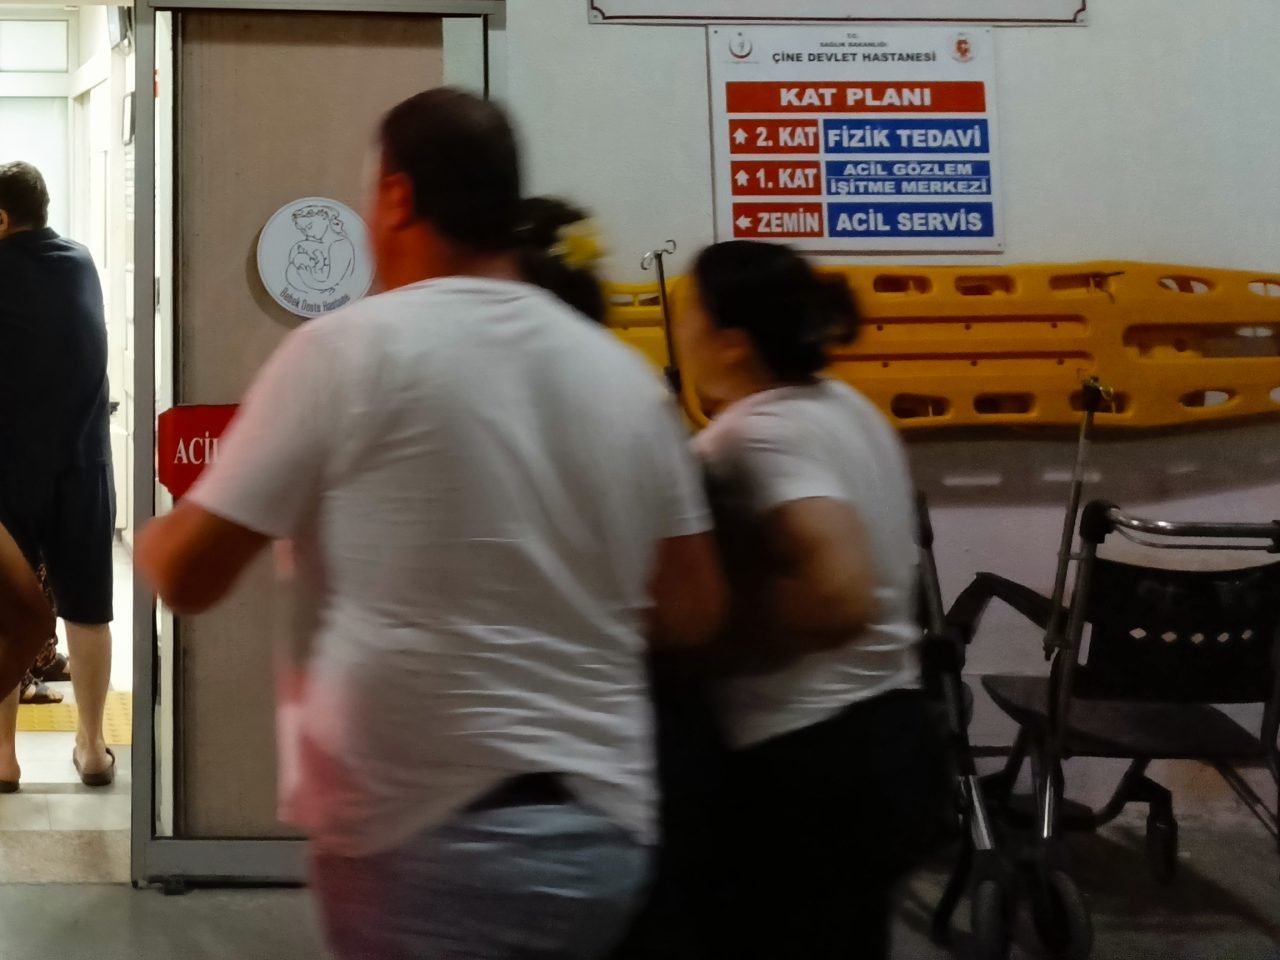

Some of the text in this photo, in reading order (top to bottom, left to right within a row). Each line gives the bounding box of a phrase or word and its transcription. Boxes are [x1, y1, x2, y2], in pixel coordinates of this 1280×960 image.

[772, 52, 803, 64] ÇİNE
[808, 52, 857, 62] DEVLET
[862, 52, 937, 63] HASTANESİ
[780, 88, 932, 106] KAT PLANI
[756, 126, 817, 147] 2. KAT
[827, 125, 981, 148] FİZİK TEDAVİ
[756, 168, 817, 189] 1. KAT
[843, 162, 972, 176] ACİL GÖZLEM
[830, 177, 987, 196] İŞİTME MERKEZİ
[757, 208, 820, 233] ZEMİN
[836, 209, 982, 231] ACİL SERVİS
